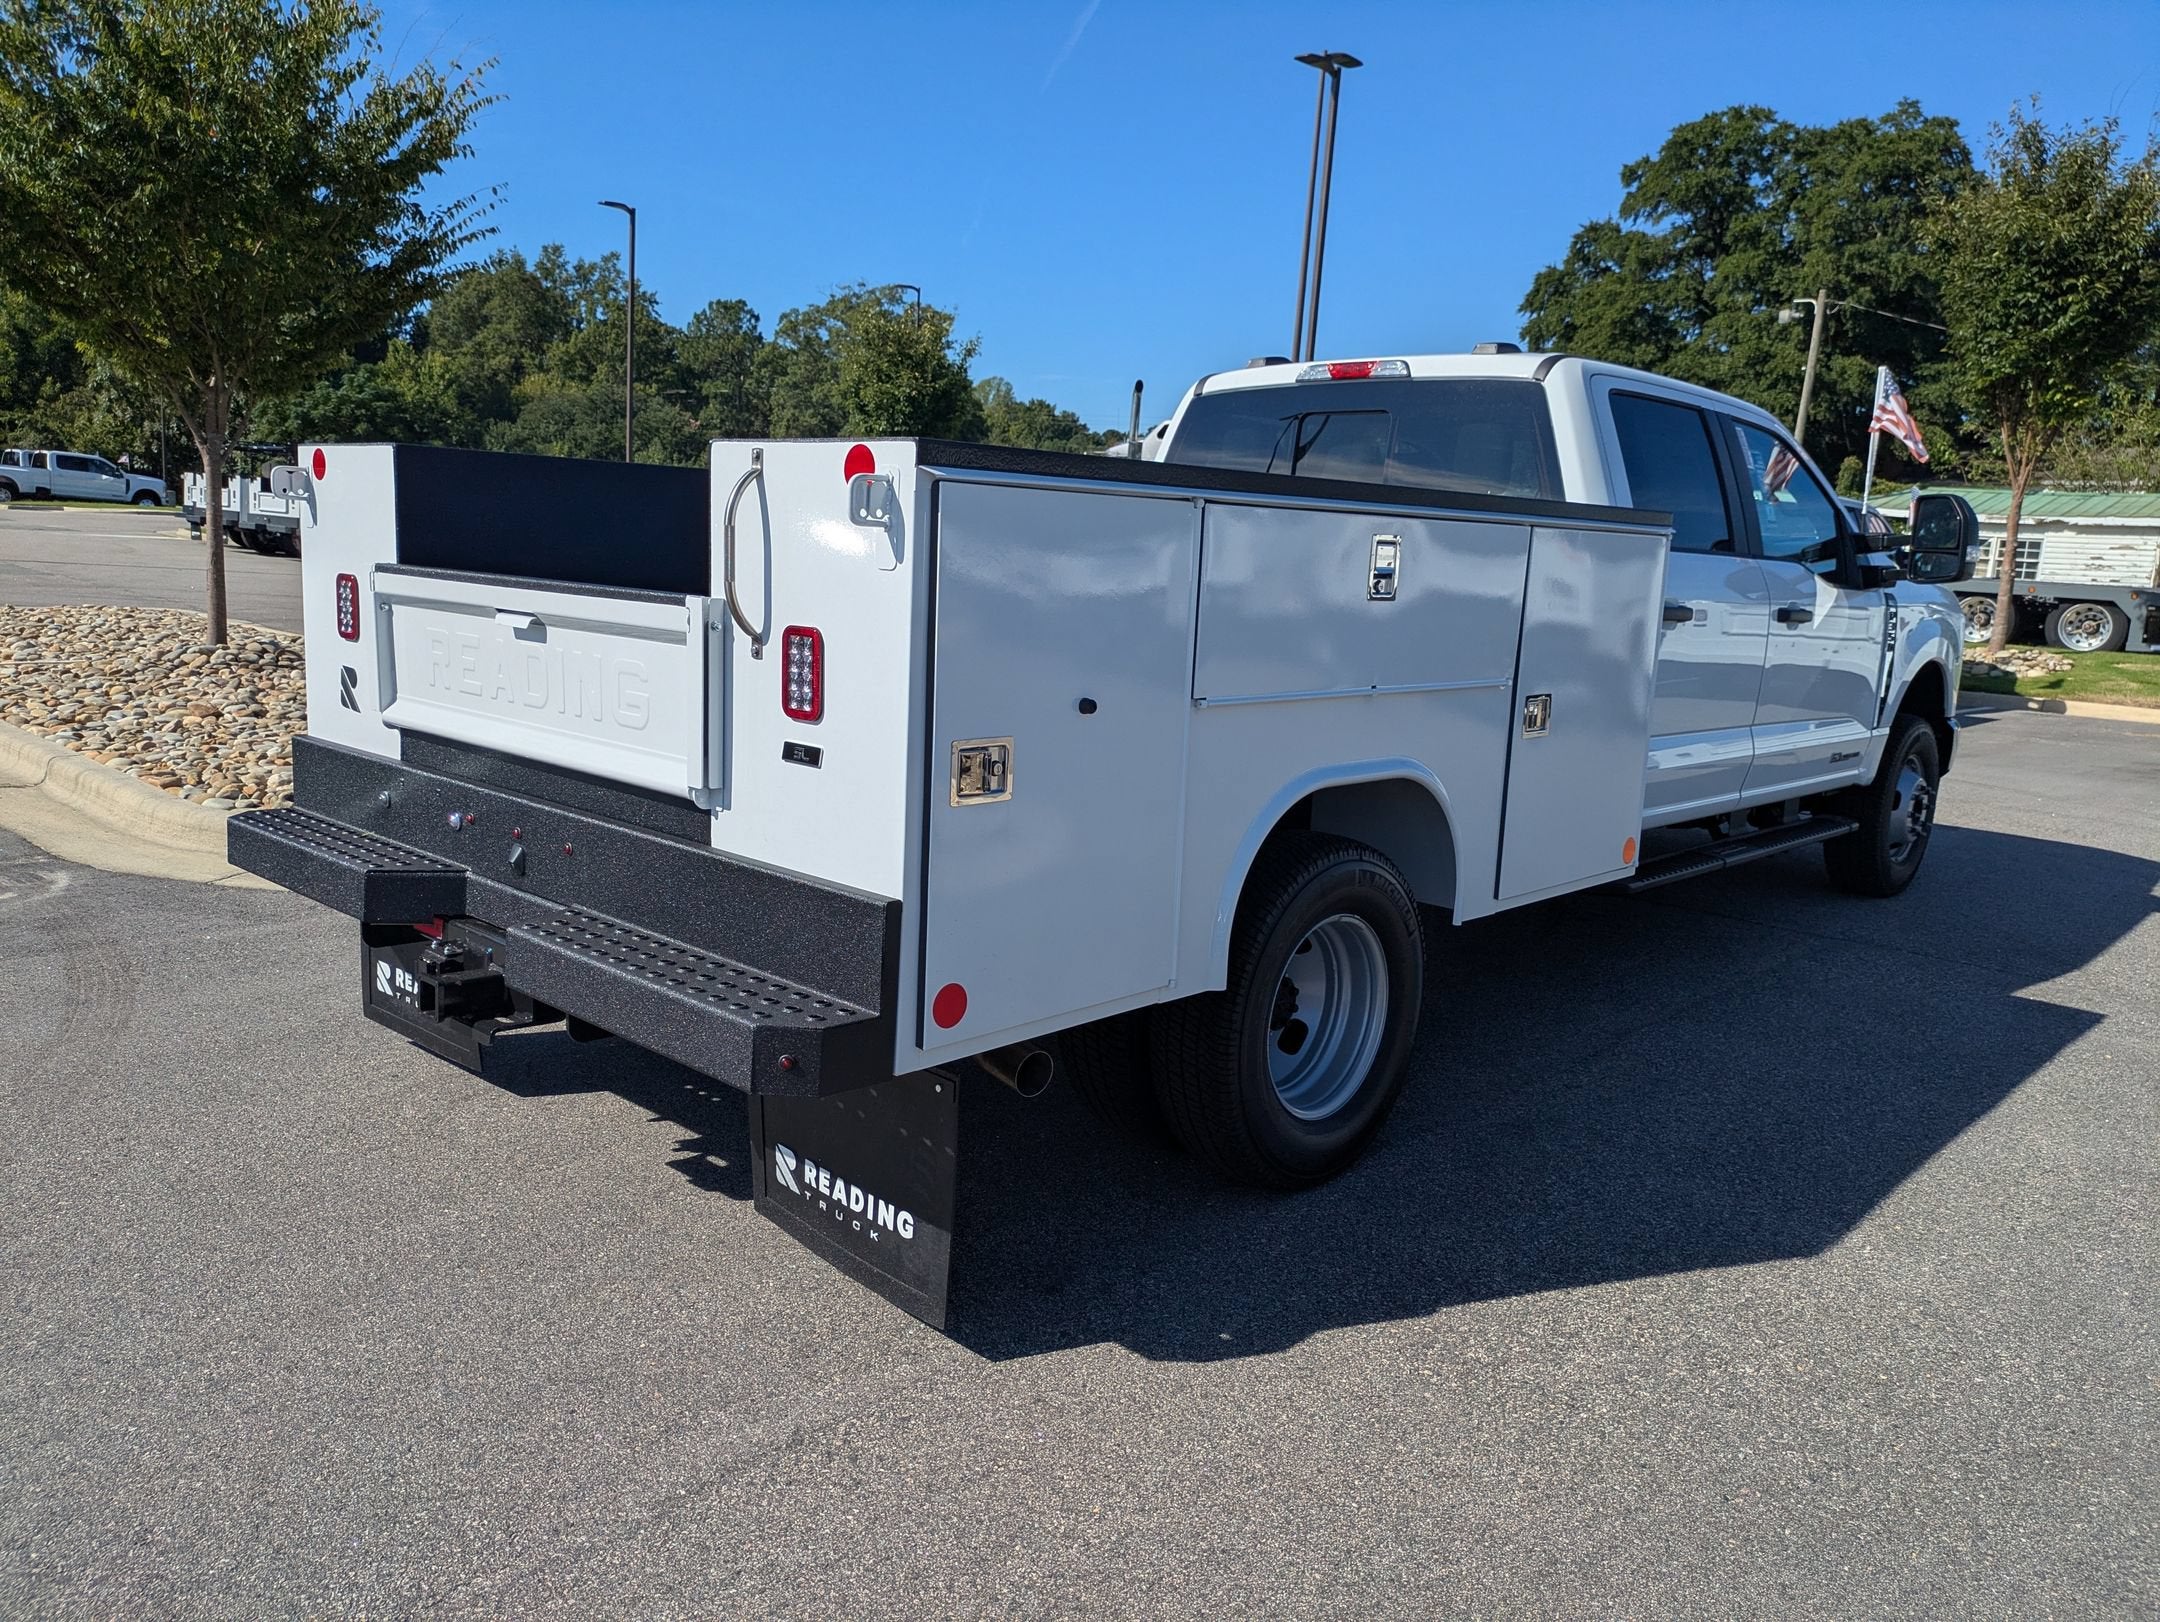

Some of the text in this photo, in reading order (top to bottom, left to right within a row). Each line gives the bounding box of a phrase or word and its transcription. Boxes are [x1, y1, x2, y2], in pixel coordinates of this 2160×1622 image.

[425, 626, 651, 730] READING
[804, 1158, 914, 1239] READING
[804, 1190, 880, 1242] TRUCK
